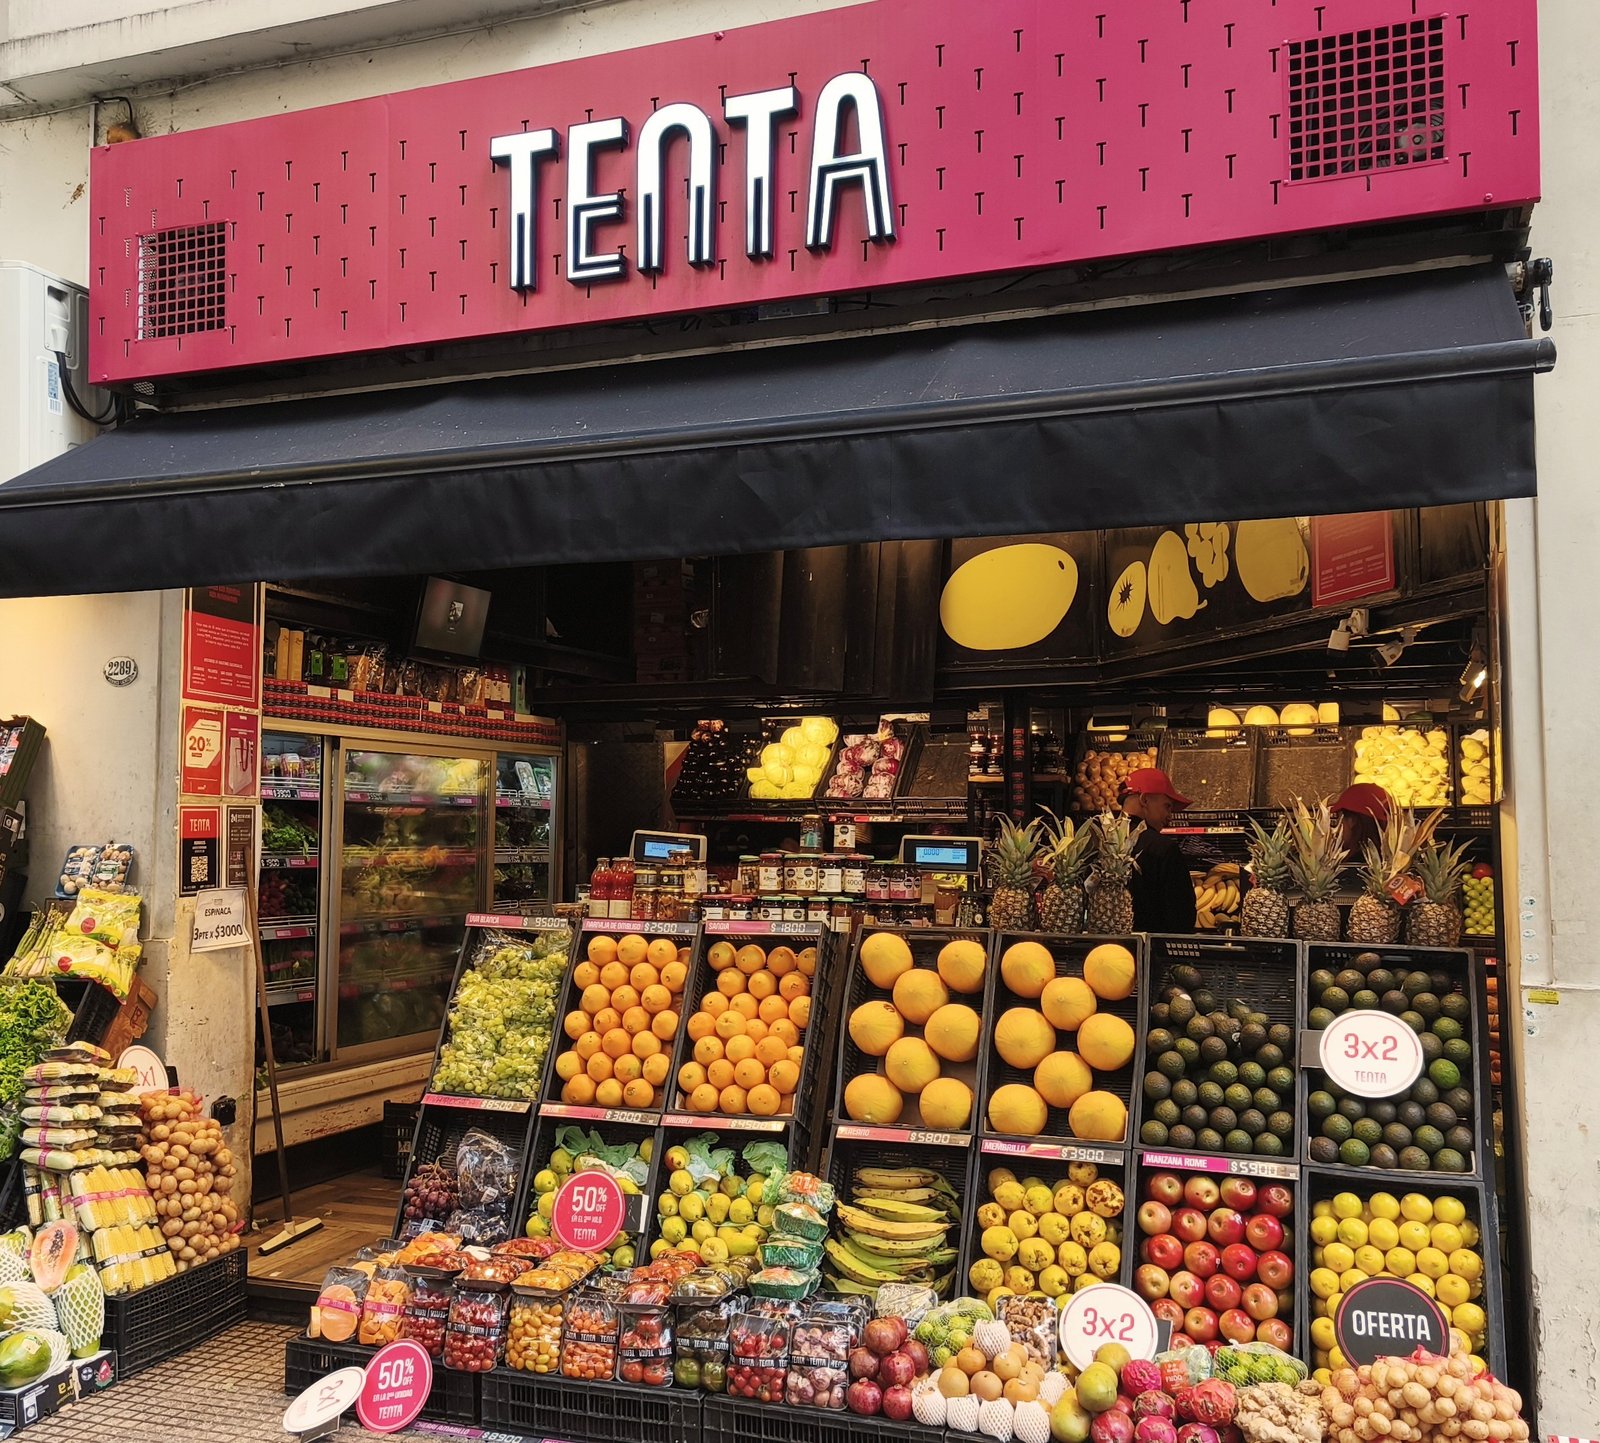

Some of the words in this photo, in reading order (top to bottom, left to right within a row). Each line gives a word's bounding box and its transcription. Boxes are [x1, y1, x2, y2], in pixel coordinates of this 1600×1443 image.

[490, 72, 897, 293] TENTA
[108, 660, 131, 676] 2289
[189, 736, 211, 752] 20%
[190, 818, 211, 832] TENTA
[204, 907, 231, 917] ESPINACA
[480, 915, 500, 925] BLANCA
[708, 922, 730, 930] SANDIA
[215, 924, 243, 940] $3000
[645, 922, 678, 933] $2500
[1344, 1033, 1398, 1061] 3x2
[1354, 1070, 1387, 1084] TENTA
[605, 1109, 641, 1122] $3000
[909, 1131, 950, 1144] $5800
[984, 1141, 1026, 1153] MEMBRILLO
[1061, 1147, 1105, 1161] $3900
[1145, 1154, 1183, 1166] MANZANA
[1184, 1158, 1207, 1168] ROME
[1231, 1162, 1278, 1173] $5900
[571, 1186, 608, 1213] 50%
[595, 1203, 607, 1212] OFF
[573, 1228, 597, 1241] TENTA
[1082, 1307, 1135, 1342] 3x2
[1352, 1310, 1432, 1341] OFERTA
[378, 1358, 415, 1390] 50%
[402, 1376, 413, 1386] OFF
[378, 1404, 403, 1420] TENTA
[482, 1431, 523, 1443] $8900
